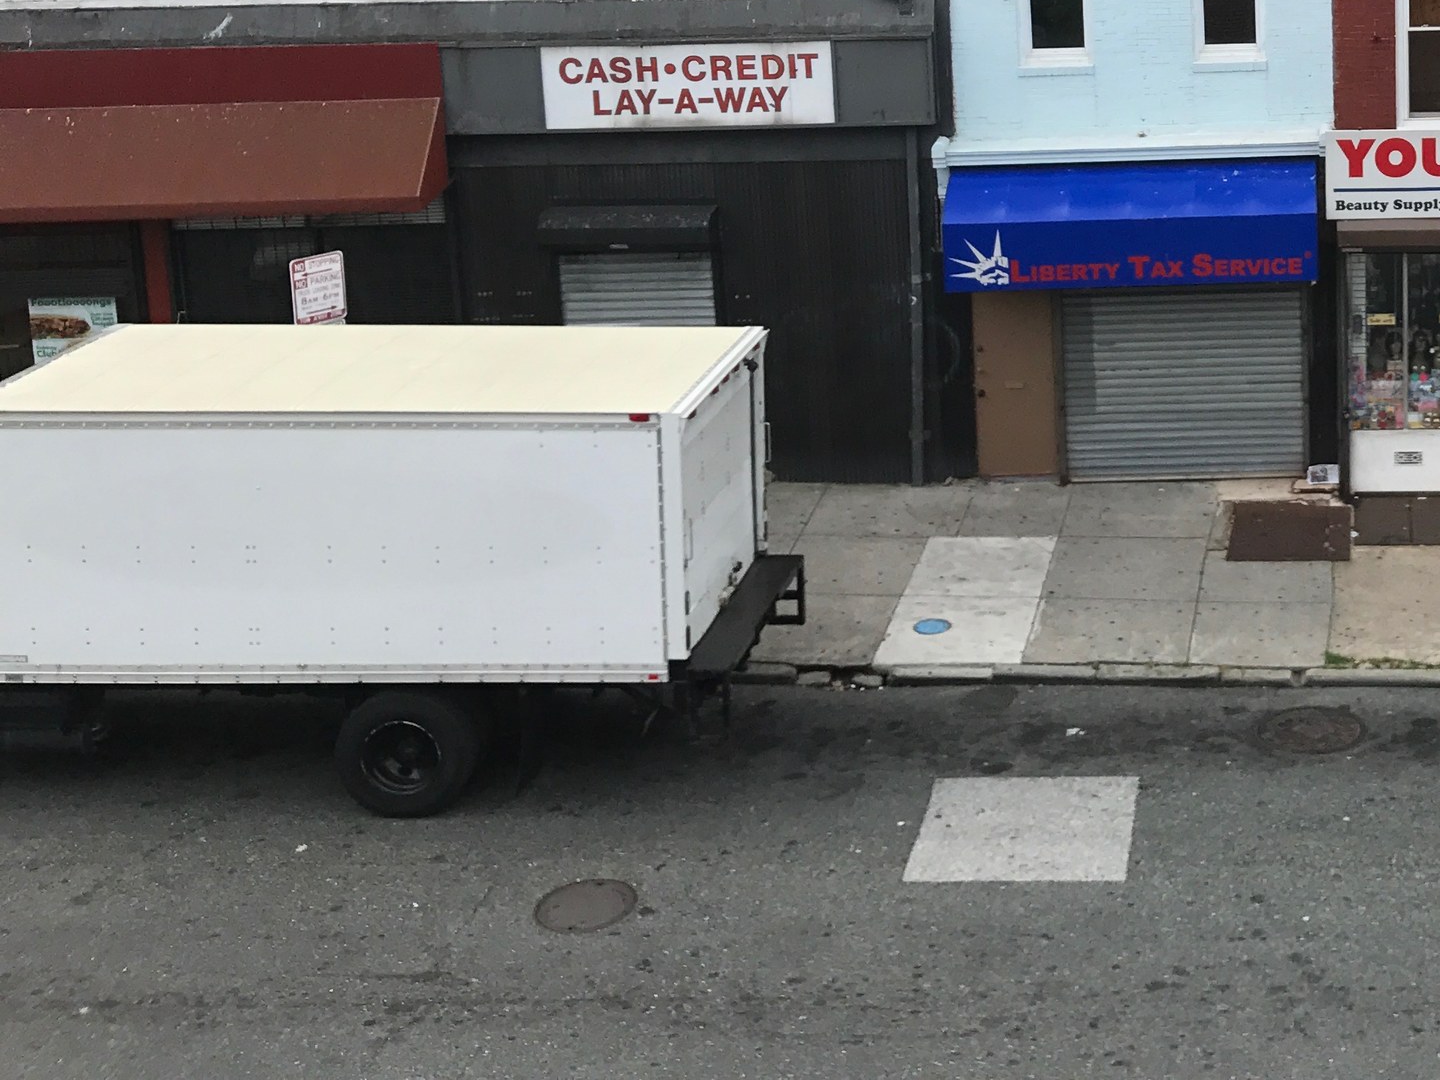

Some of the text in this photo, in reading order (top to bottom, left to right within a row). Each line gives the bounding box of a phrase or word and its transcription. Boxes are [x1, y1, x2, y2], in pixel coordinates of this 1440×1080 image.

[592, 86, 789, 116] LAY-A-WAY
[1335, 200, 1389, 213] Beauty
[294, 262, 305, 272] NO
[1010, 259, 1120, 283] LIBERTY
[1127, 255, 1184, 279] TAX
[295, 280, 307, 289] NO
